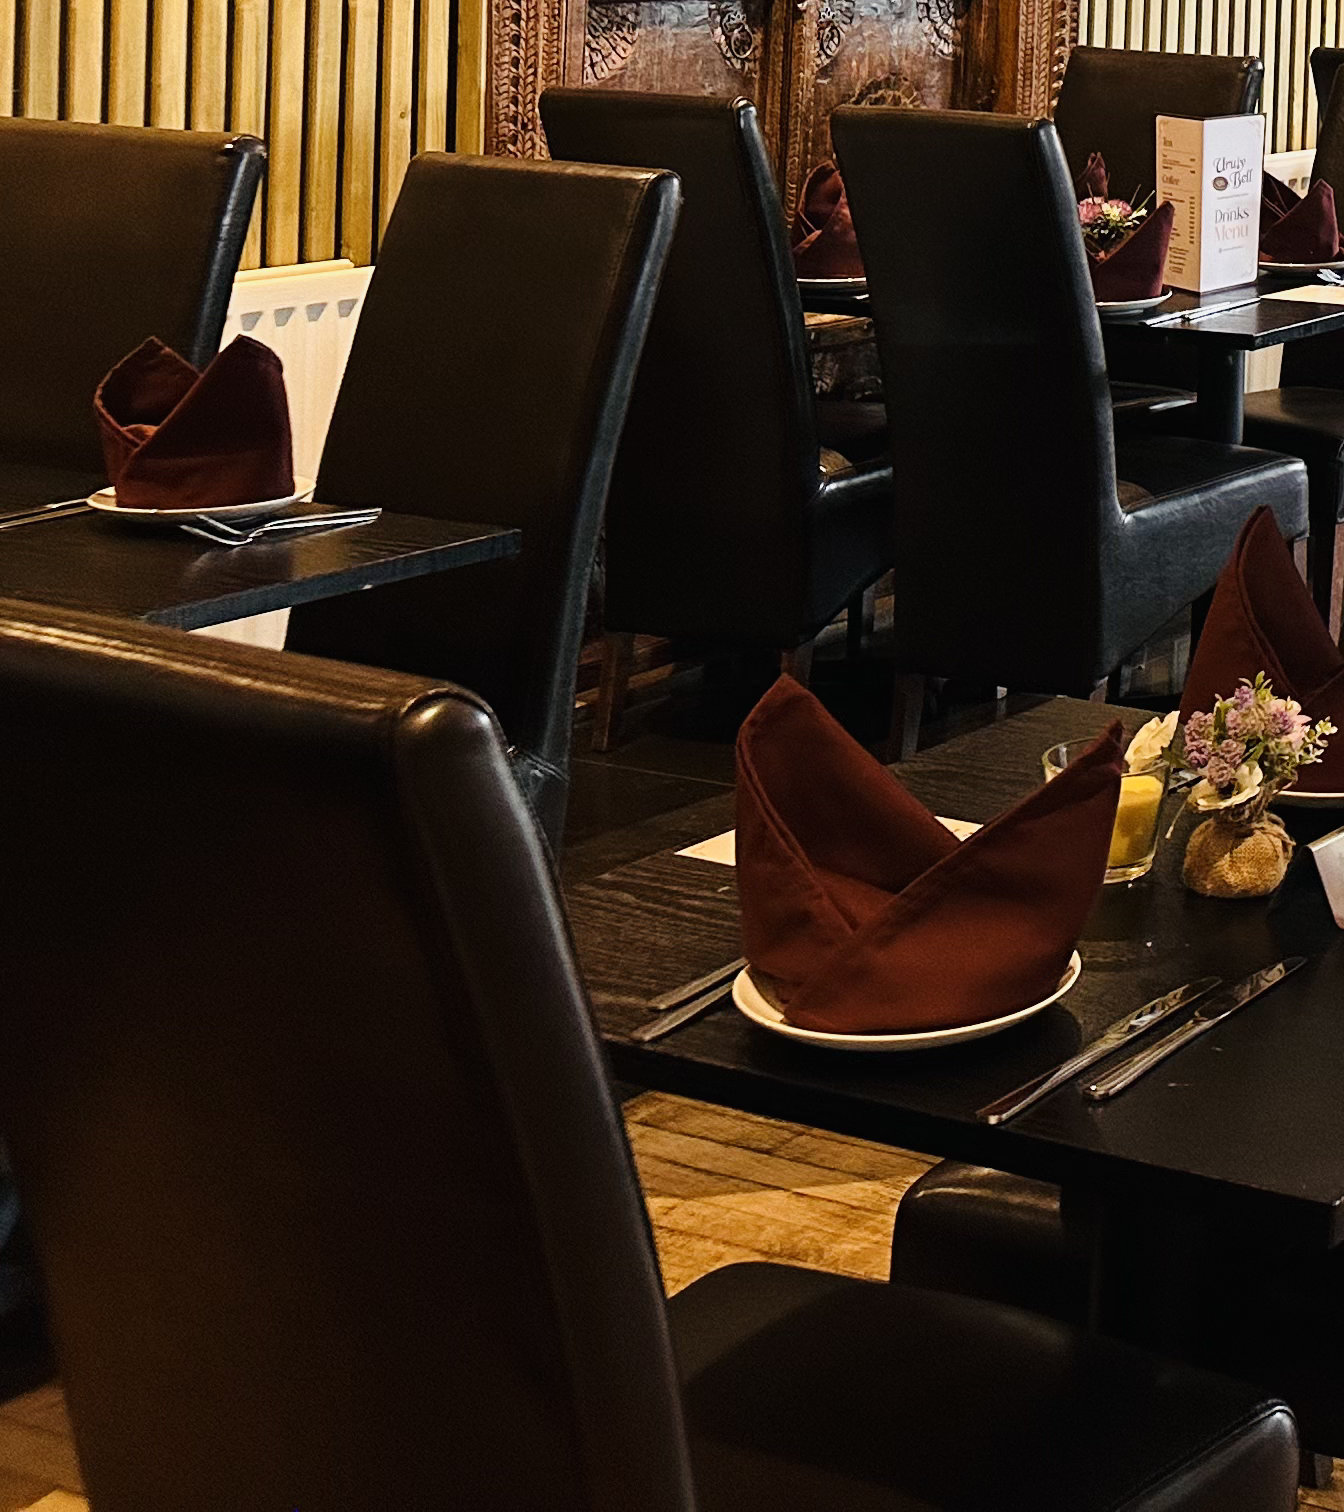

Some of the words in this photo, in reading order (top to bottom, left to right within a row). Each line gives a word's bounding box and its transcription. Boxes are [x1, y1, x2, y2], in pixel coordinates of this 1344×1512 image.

[1230, 168, 1254, 189] Bell
[1215, 206, 1250, 224] Drinks
[1214, 224, 1249, 241] Menu
